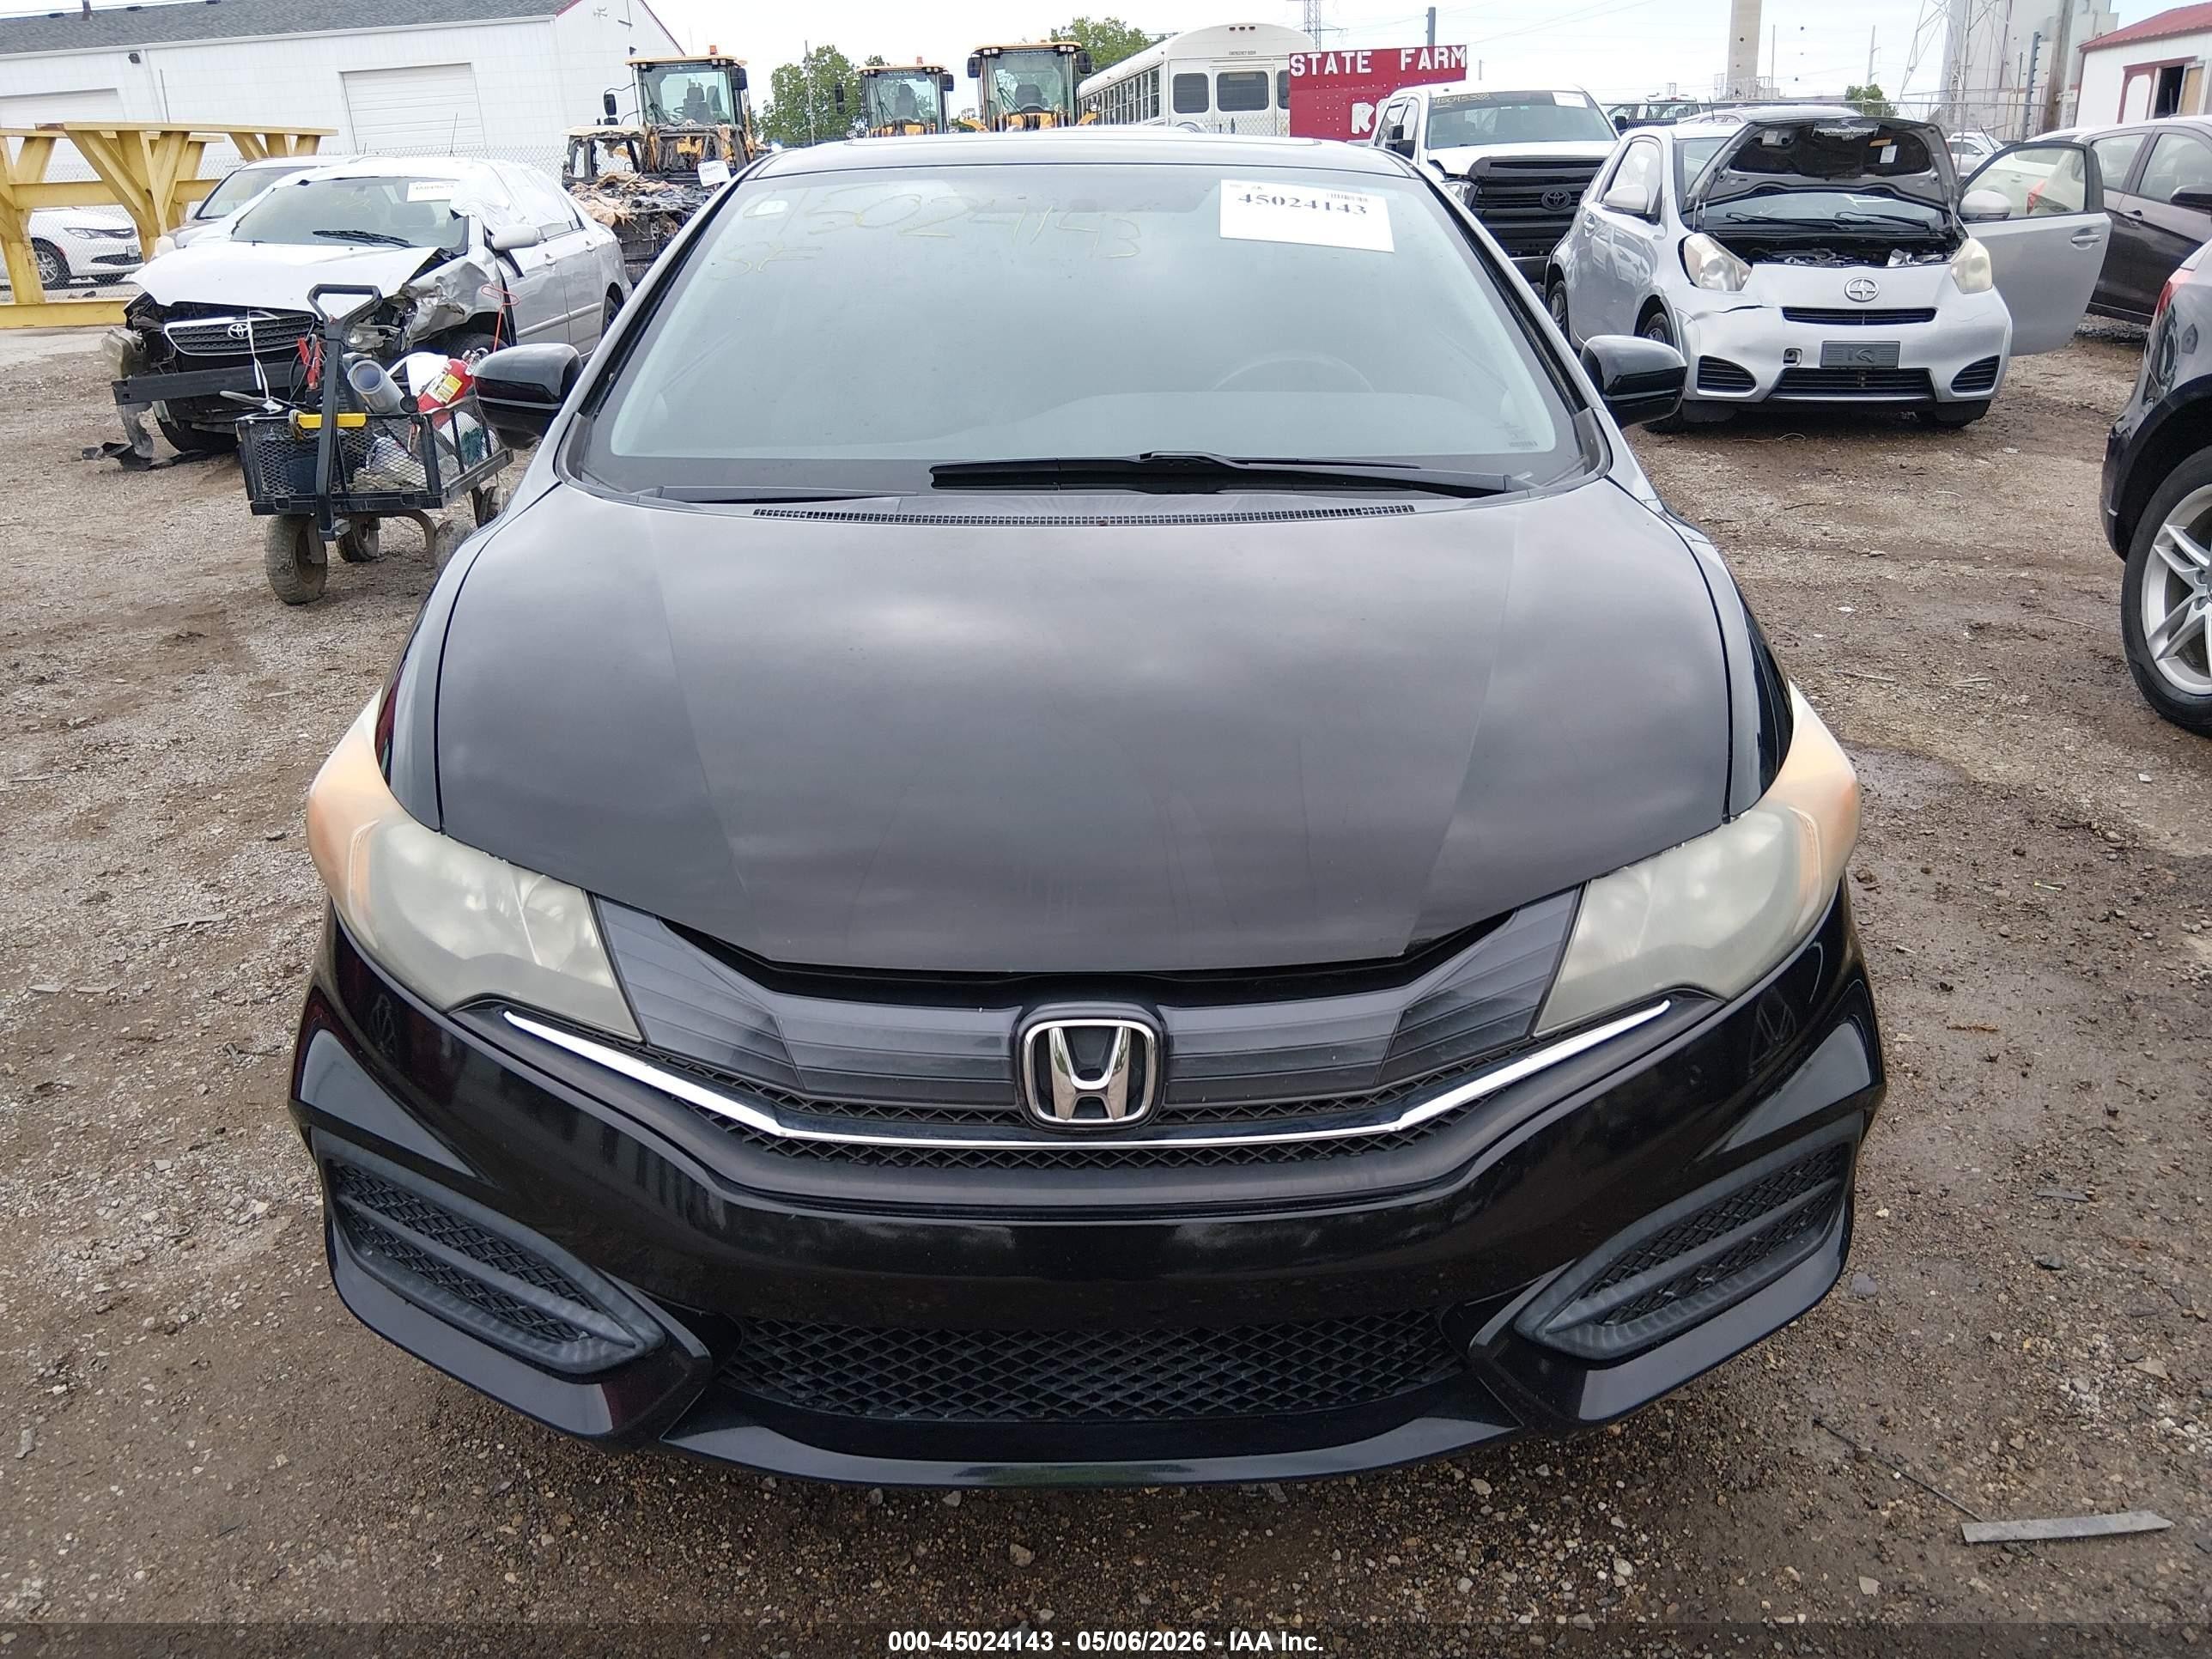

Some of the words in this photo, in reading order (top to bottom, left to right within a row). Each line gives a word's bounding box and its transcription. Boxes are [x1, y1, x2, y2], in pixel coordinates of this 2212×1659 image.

[1290, 52, 1372, 76] STATE
[1400, 46, 1467, 71] FARM
[1237, 193, 1367, 215] 45024143
